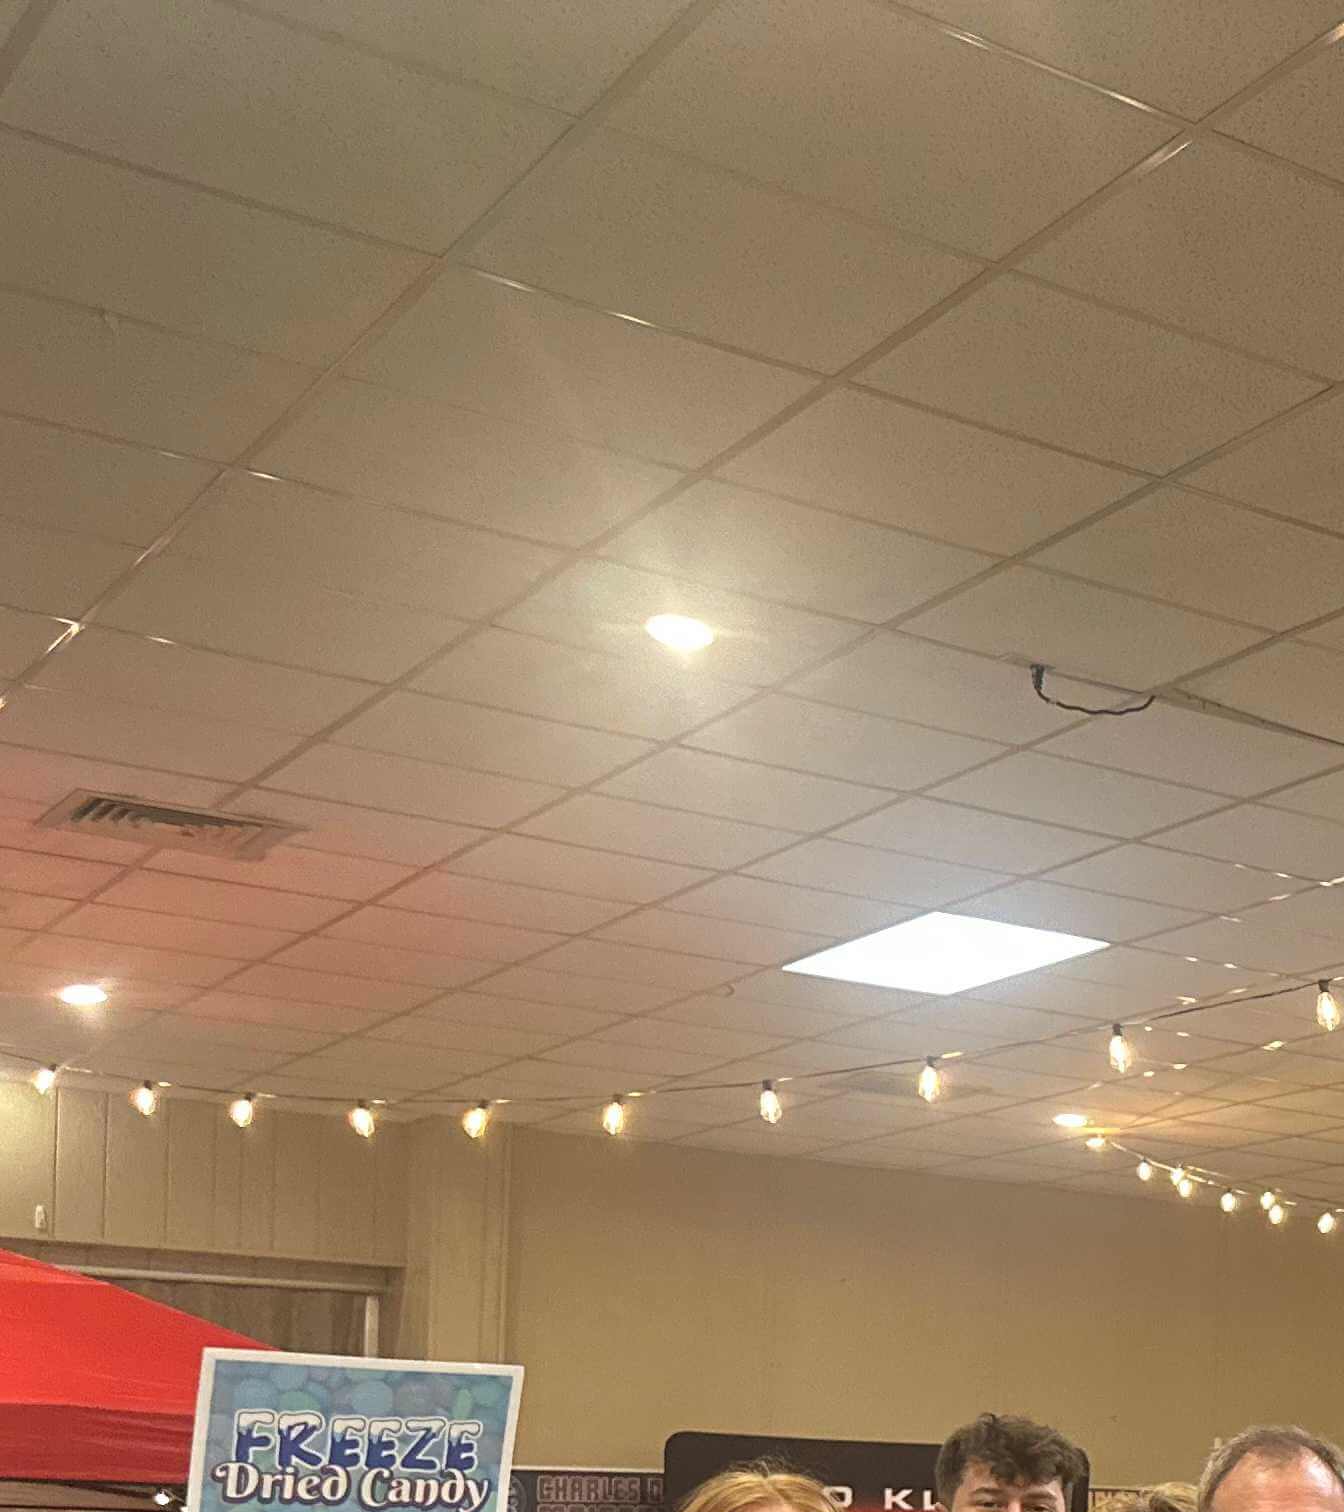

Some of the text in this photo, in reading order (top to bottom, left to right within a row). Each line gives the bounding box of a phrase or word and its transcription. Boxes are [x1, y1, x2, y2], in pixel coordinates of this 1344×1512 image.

[234, 1409, 482, 1473] FREEZE
[216, 1461, 348, 1501] Dried
[537, 1475, 641, 1503] CHARLES
